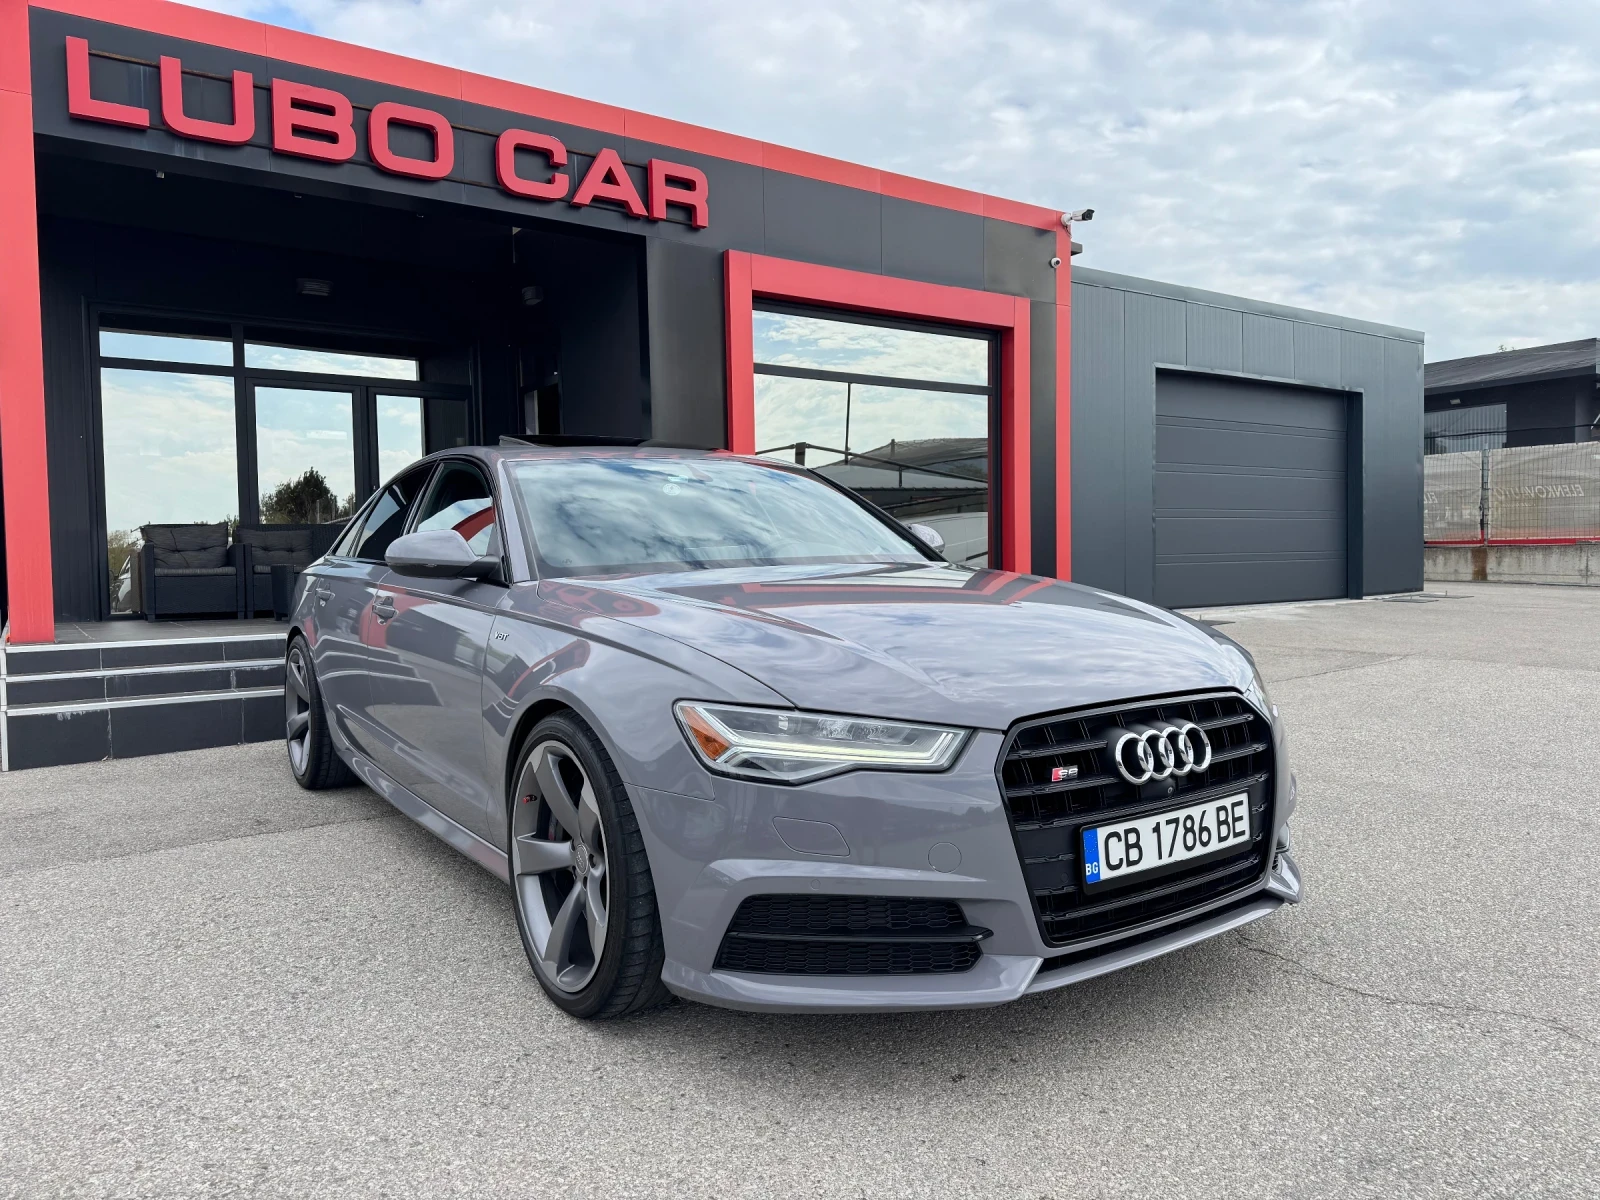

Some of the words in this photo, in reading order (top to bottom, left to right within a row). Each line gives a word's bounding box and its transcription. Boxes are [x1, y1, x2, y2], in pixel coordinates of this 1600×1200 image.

[65, 35, 455, 181] LUBO
[495, 127, 710, 230] CAR
[1085, 862, 1099, 876] BG
[1104, 827, 1143, 871] CB
[1152, 810, 1212, 861] 1786
[1216, 800, 1246, 843] BE
